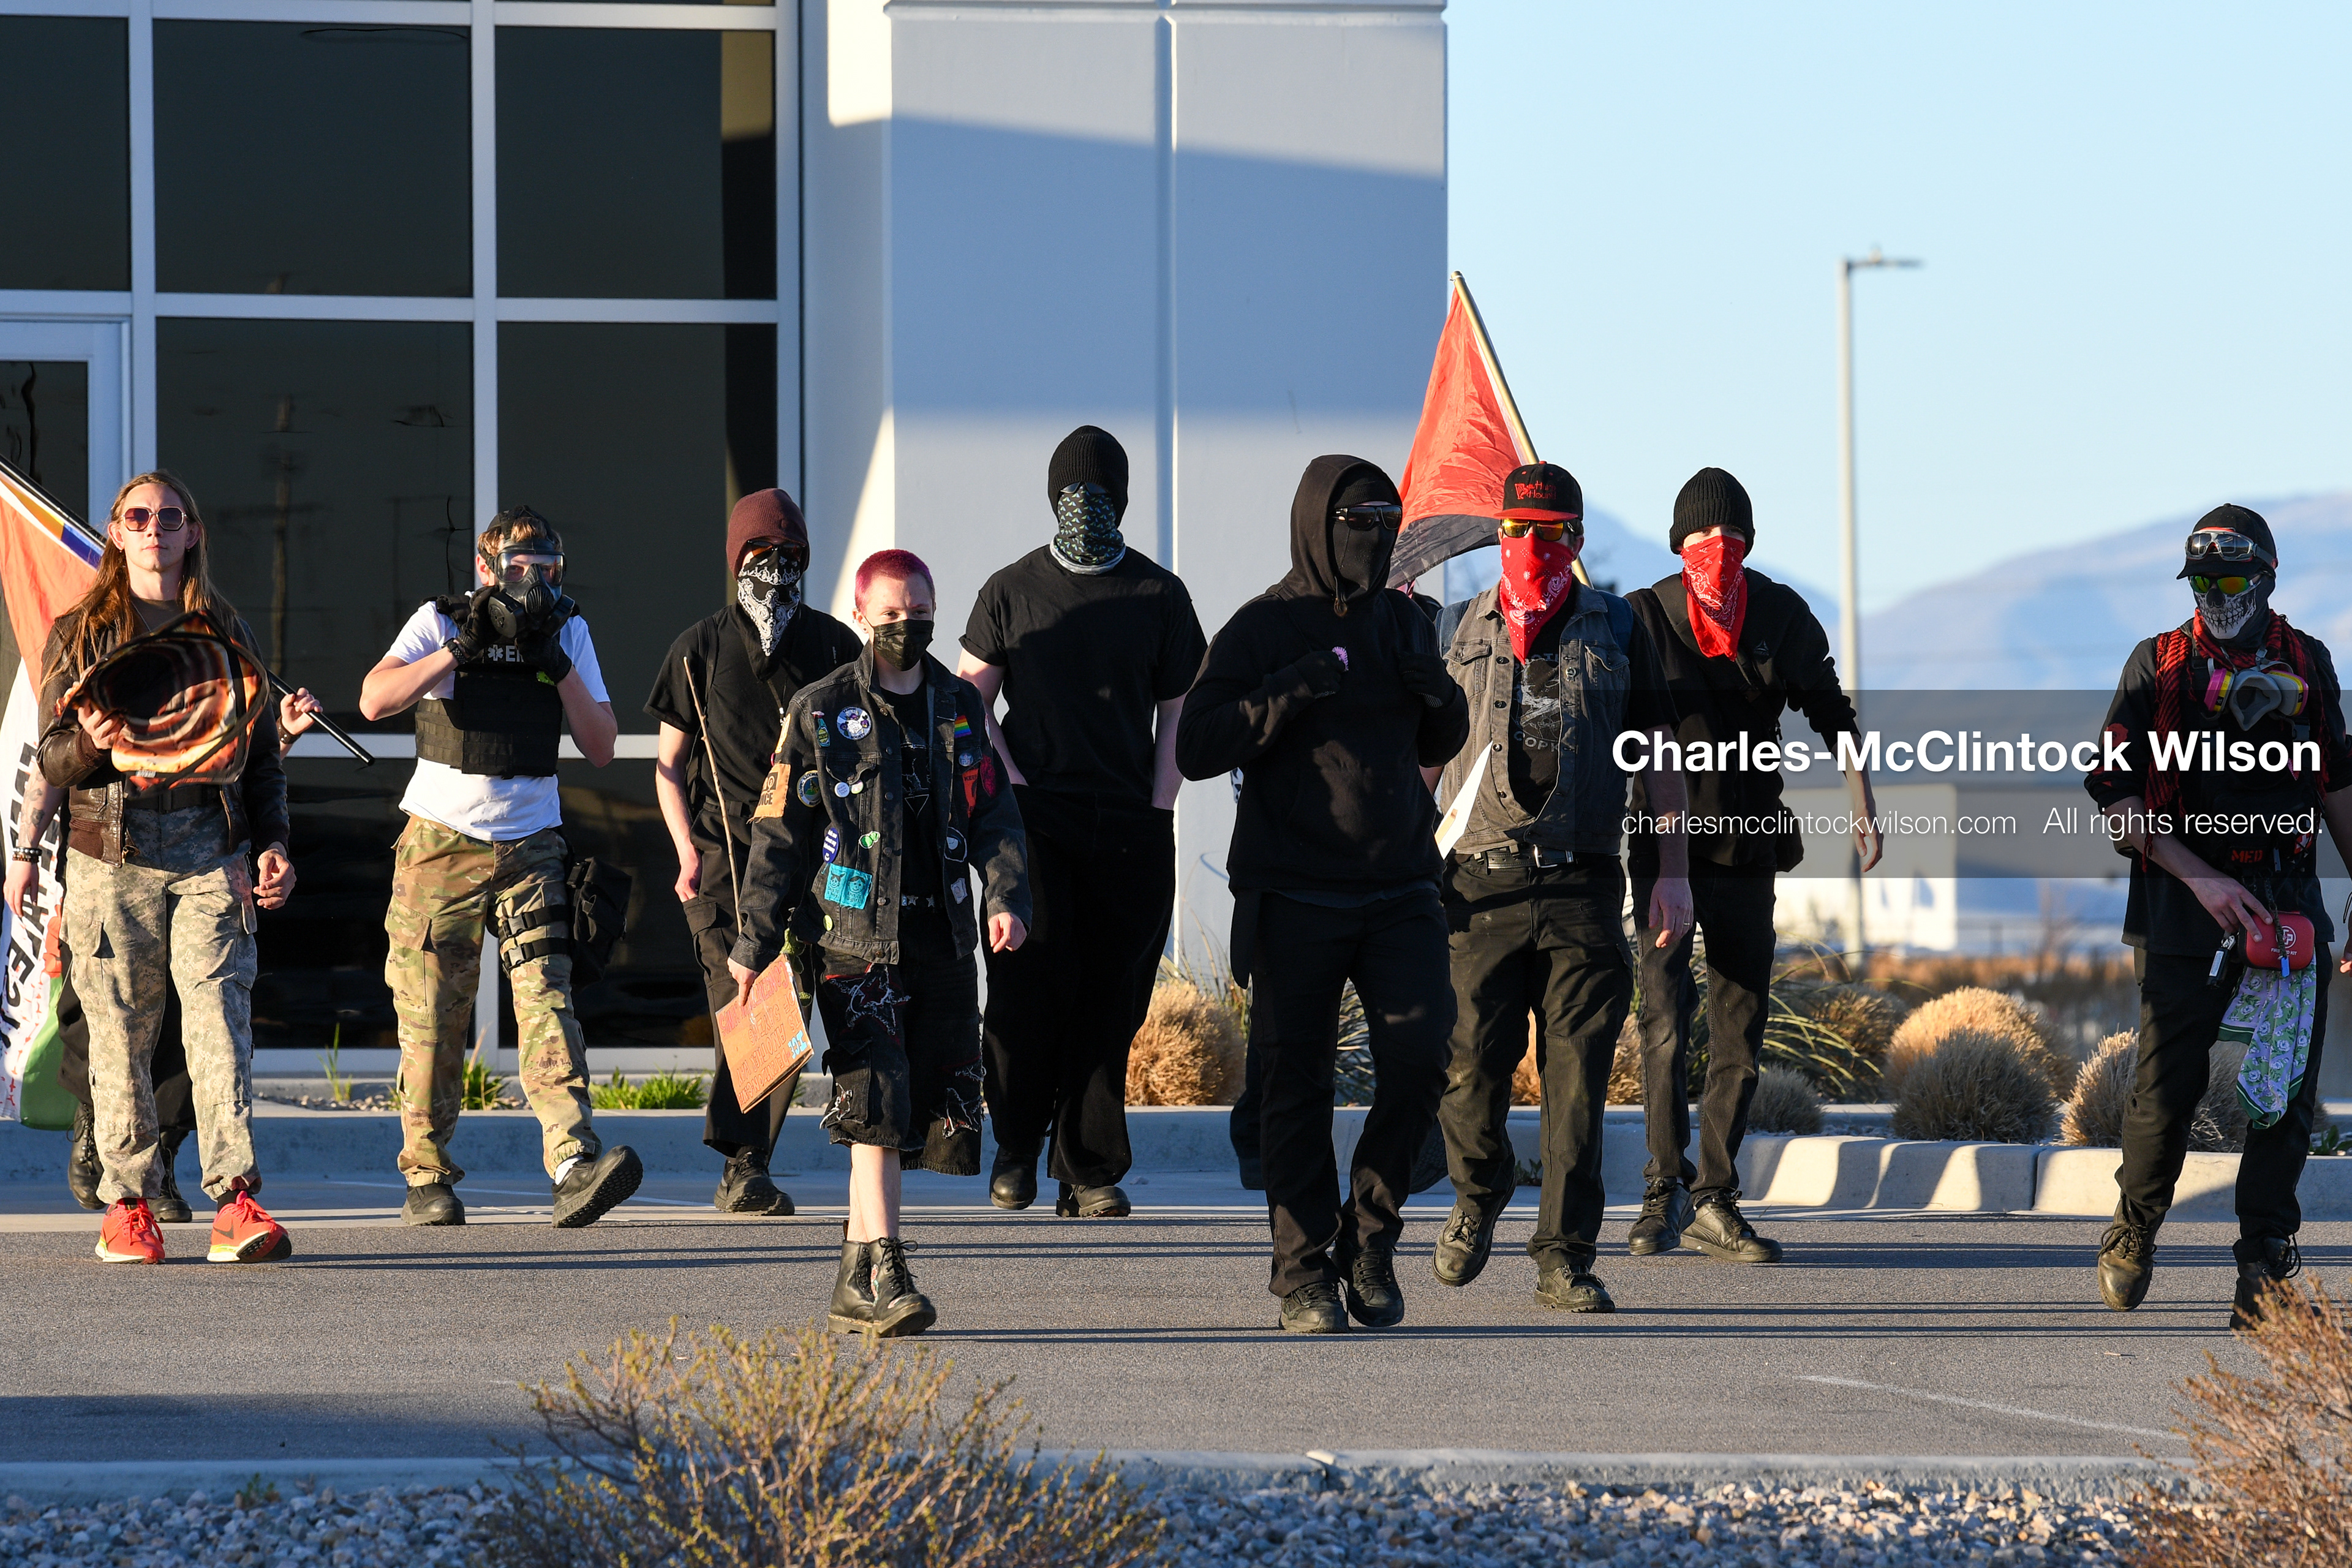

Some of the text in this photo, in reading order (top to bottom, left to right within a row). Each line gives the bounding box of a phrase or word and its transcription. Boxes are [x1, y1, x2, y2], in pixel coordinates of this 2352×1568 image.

[2231, 849, 2263, 863] MED
[788, 1011, 803, 1034] IS
[787, 1029, 808, 1060] ICE
